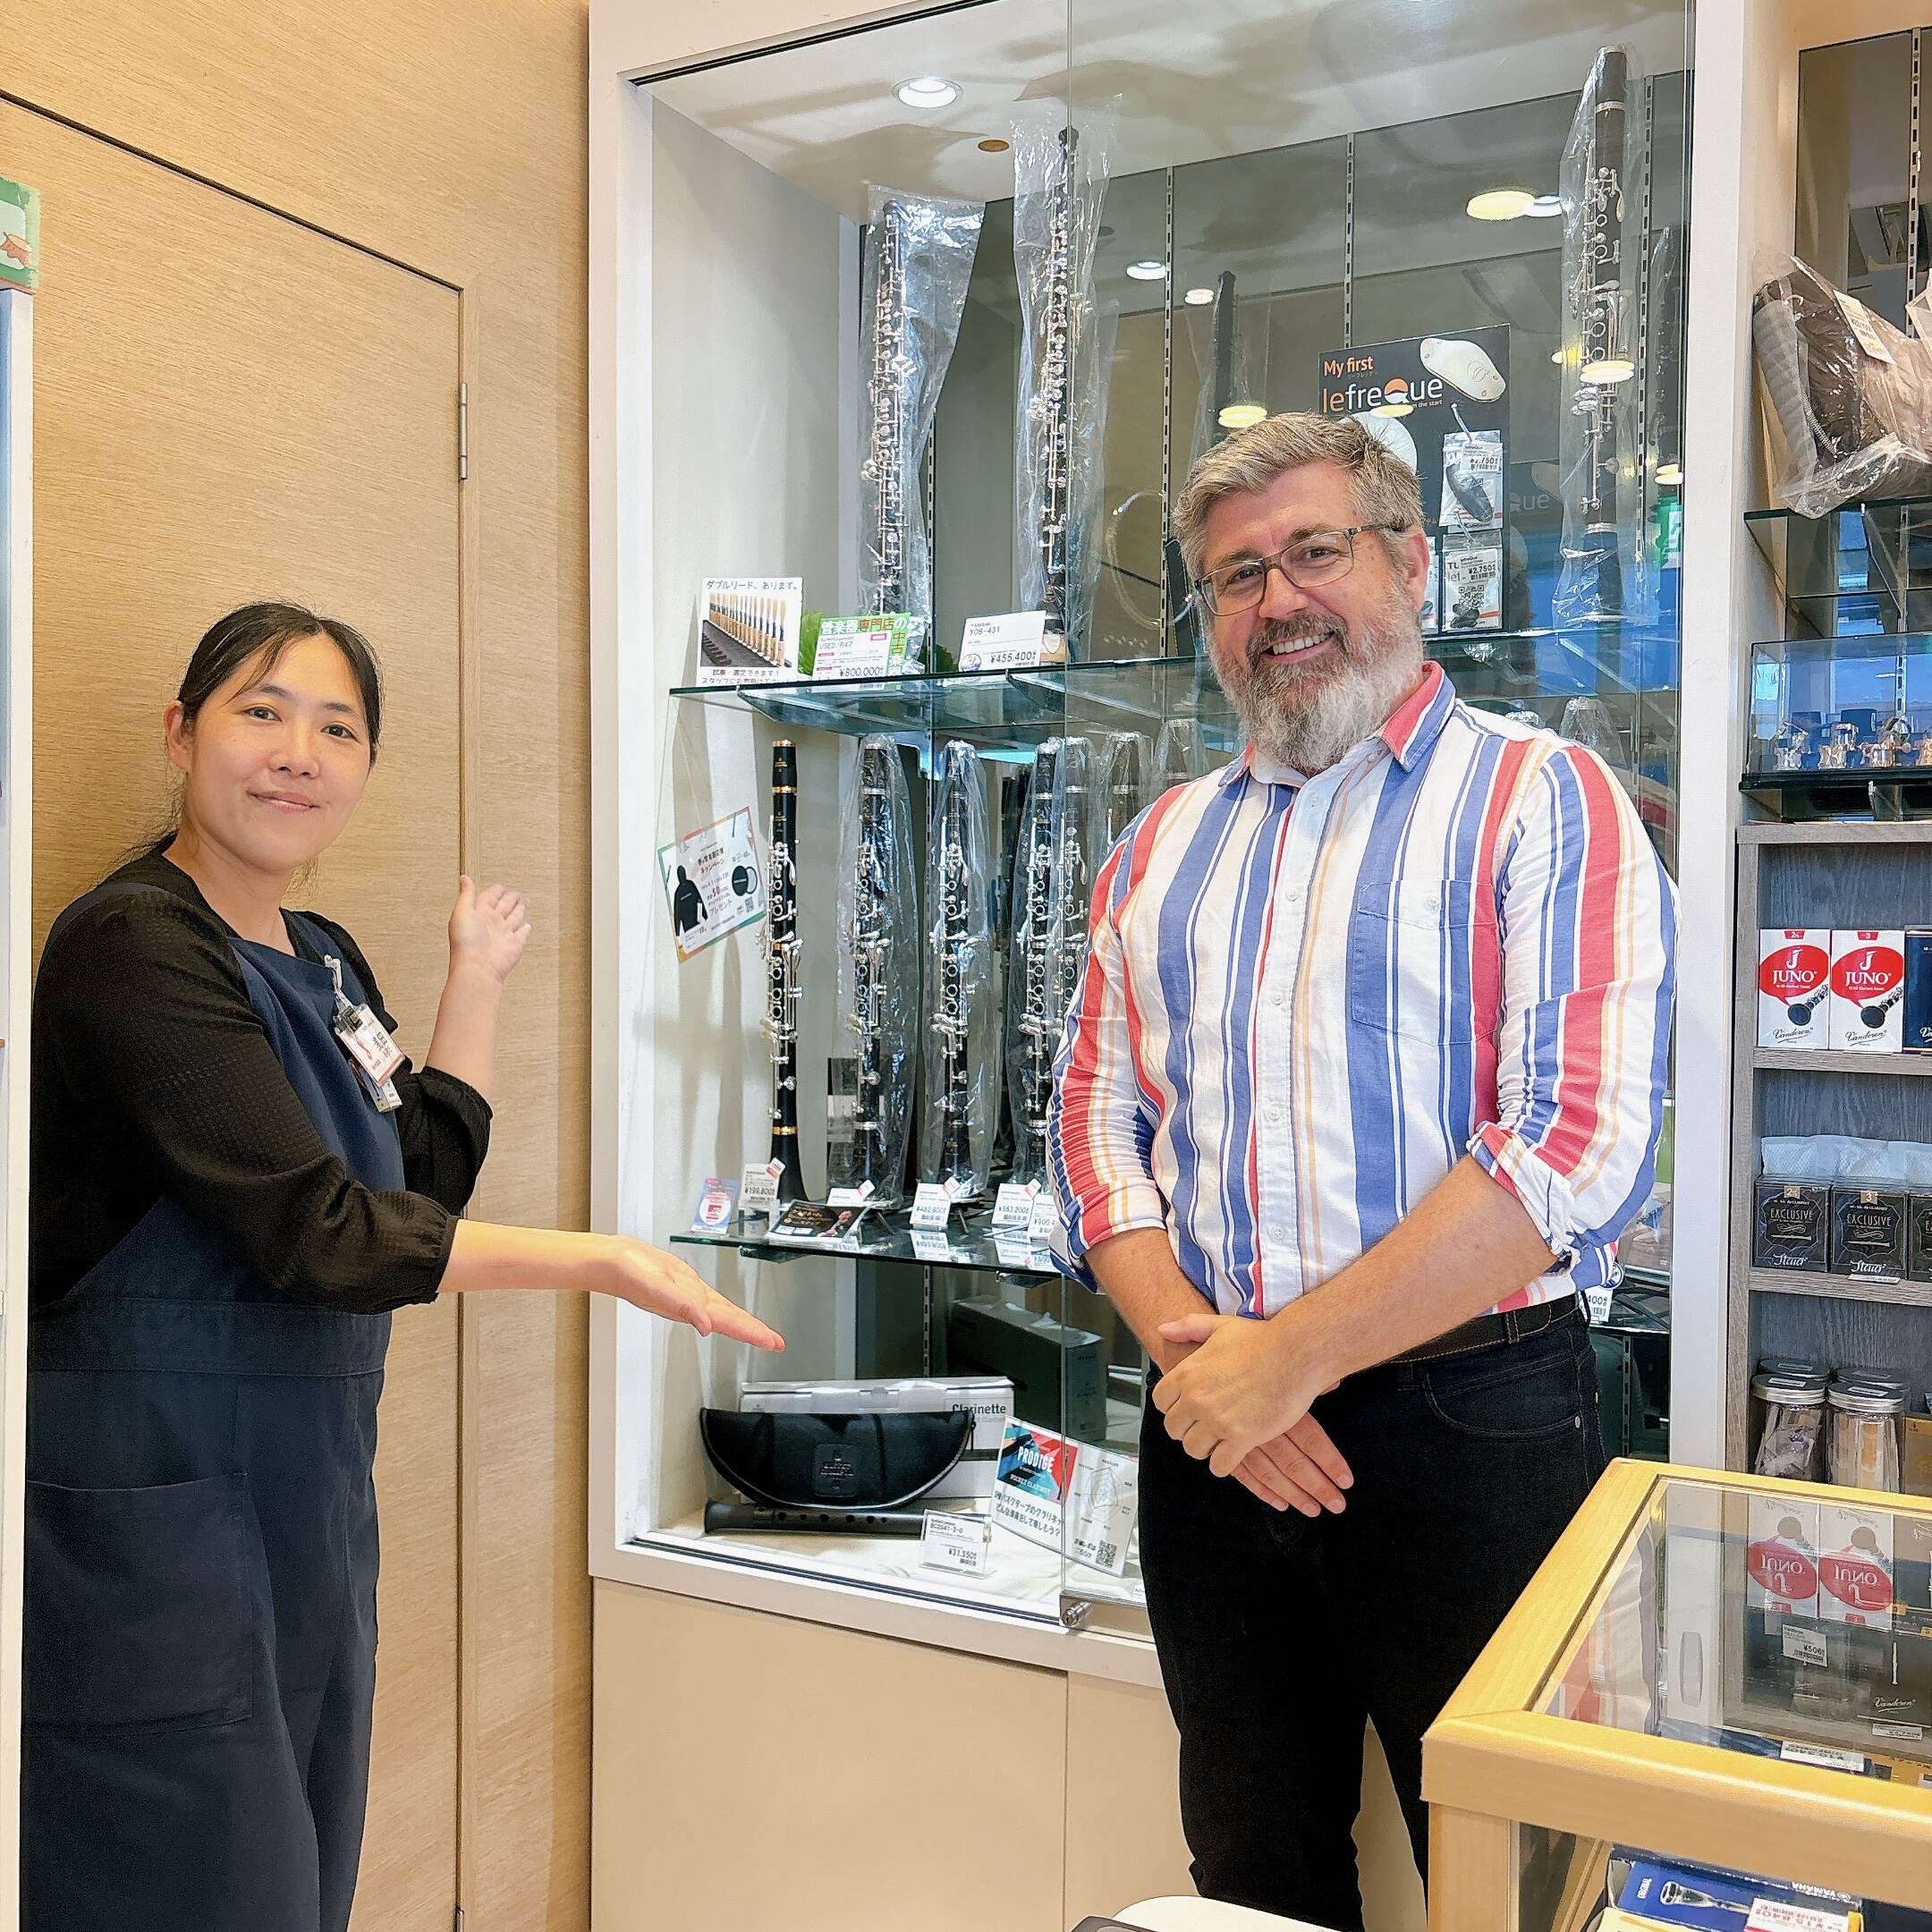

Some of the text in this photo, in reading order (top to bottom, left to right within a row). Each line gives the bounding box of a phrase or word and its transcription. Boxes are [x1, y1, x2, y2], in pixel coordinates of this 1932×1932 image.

[1324, 356, 1374, 378] My first
[1322, 377, 1444, 414] lefreQue
[707, 580, 798, 590] ダブルリード、あります。
[1773, 970, 1815, 985] JUNO
[1845, 972, 1889, 987] JUNO
[1770, 1208, 1814, 1221] EXCLUSIVE
[1846, 1212, 1892, 1227] EXCLUSIVE
